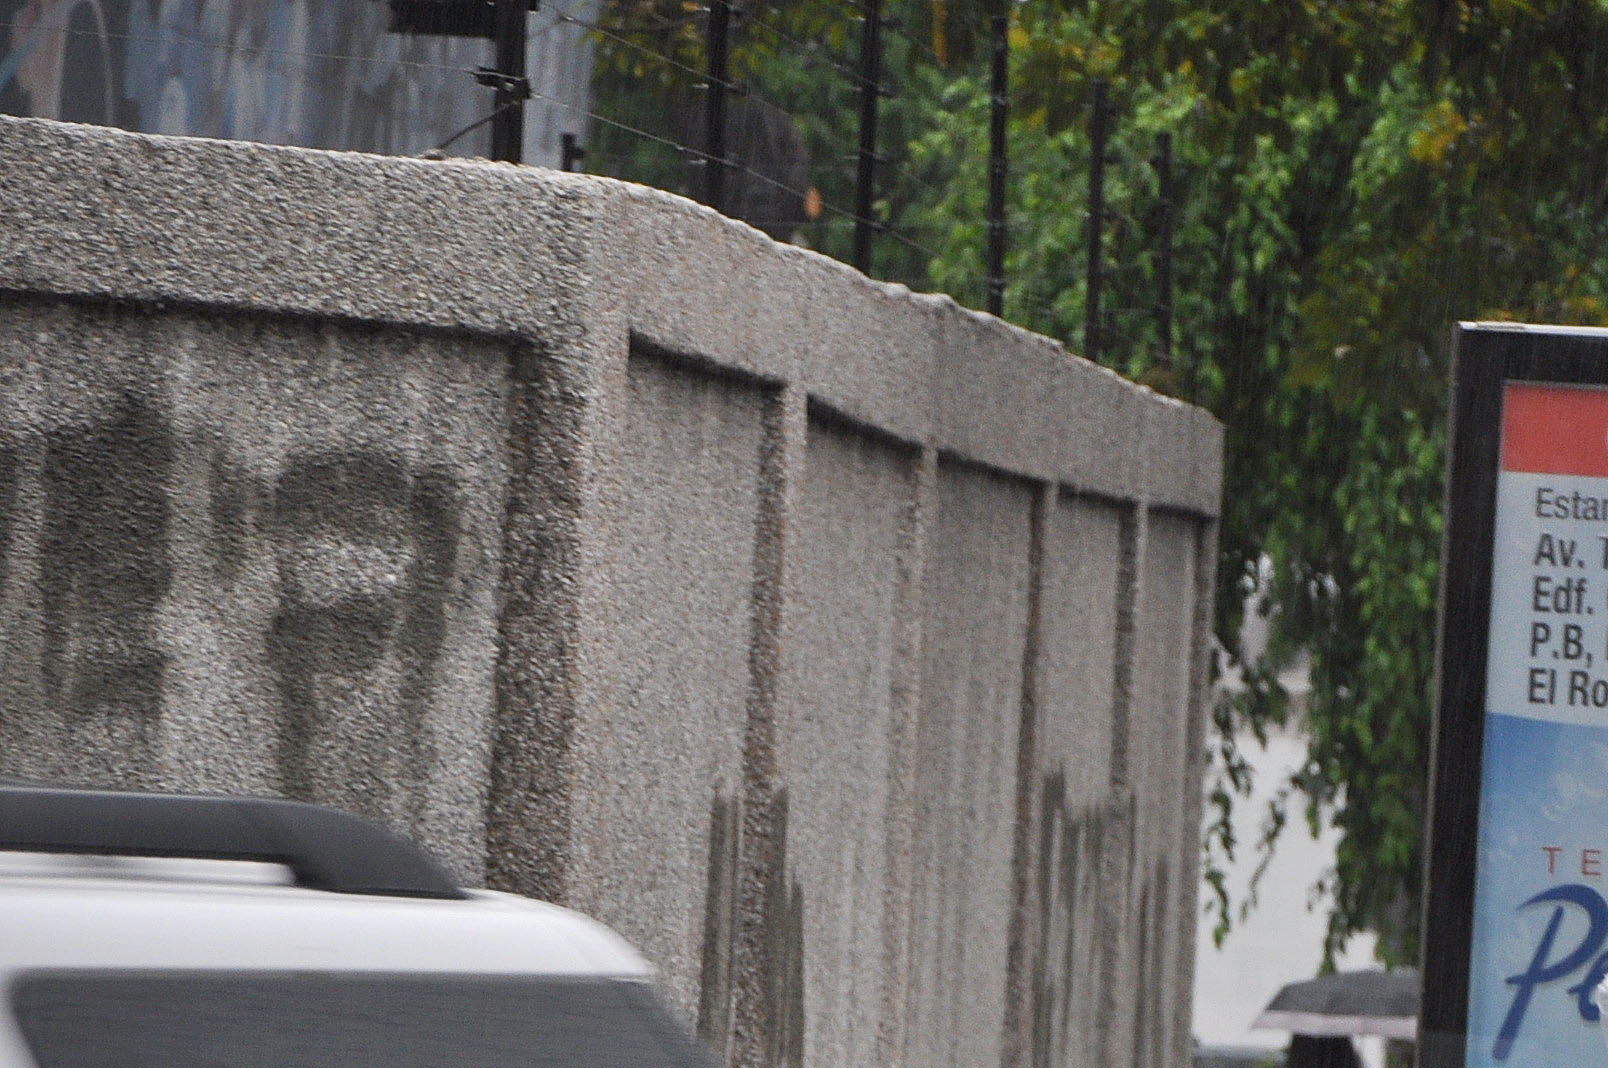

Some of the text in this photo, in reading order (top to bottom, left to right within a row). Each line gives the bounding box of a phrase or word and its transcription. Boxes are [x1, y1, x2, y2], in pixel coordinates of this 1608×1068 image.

[1534, 533, 1584, 568] Av.
[1532, 576, 1593, 615] Edf.
[1530, 622, 1592, 668] P.B,
[1528, 668, 1556, 705] El
